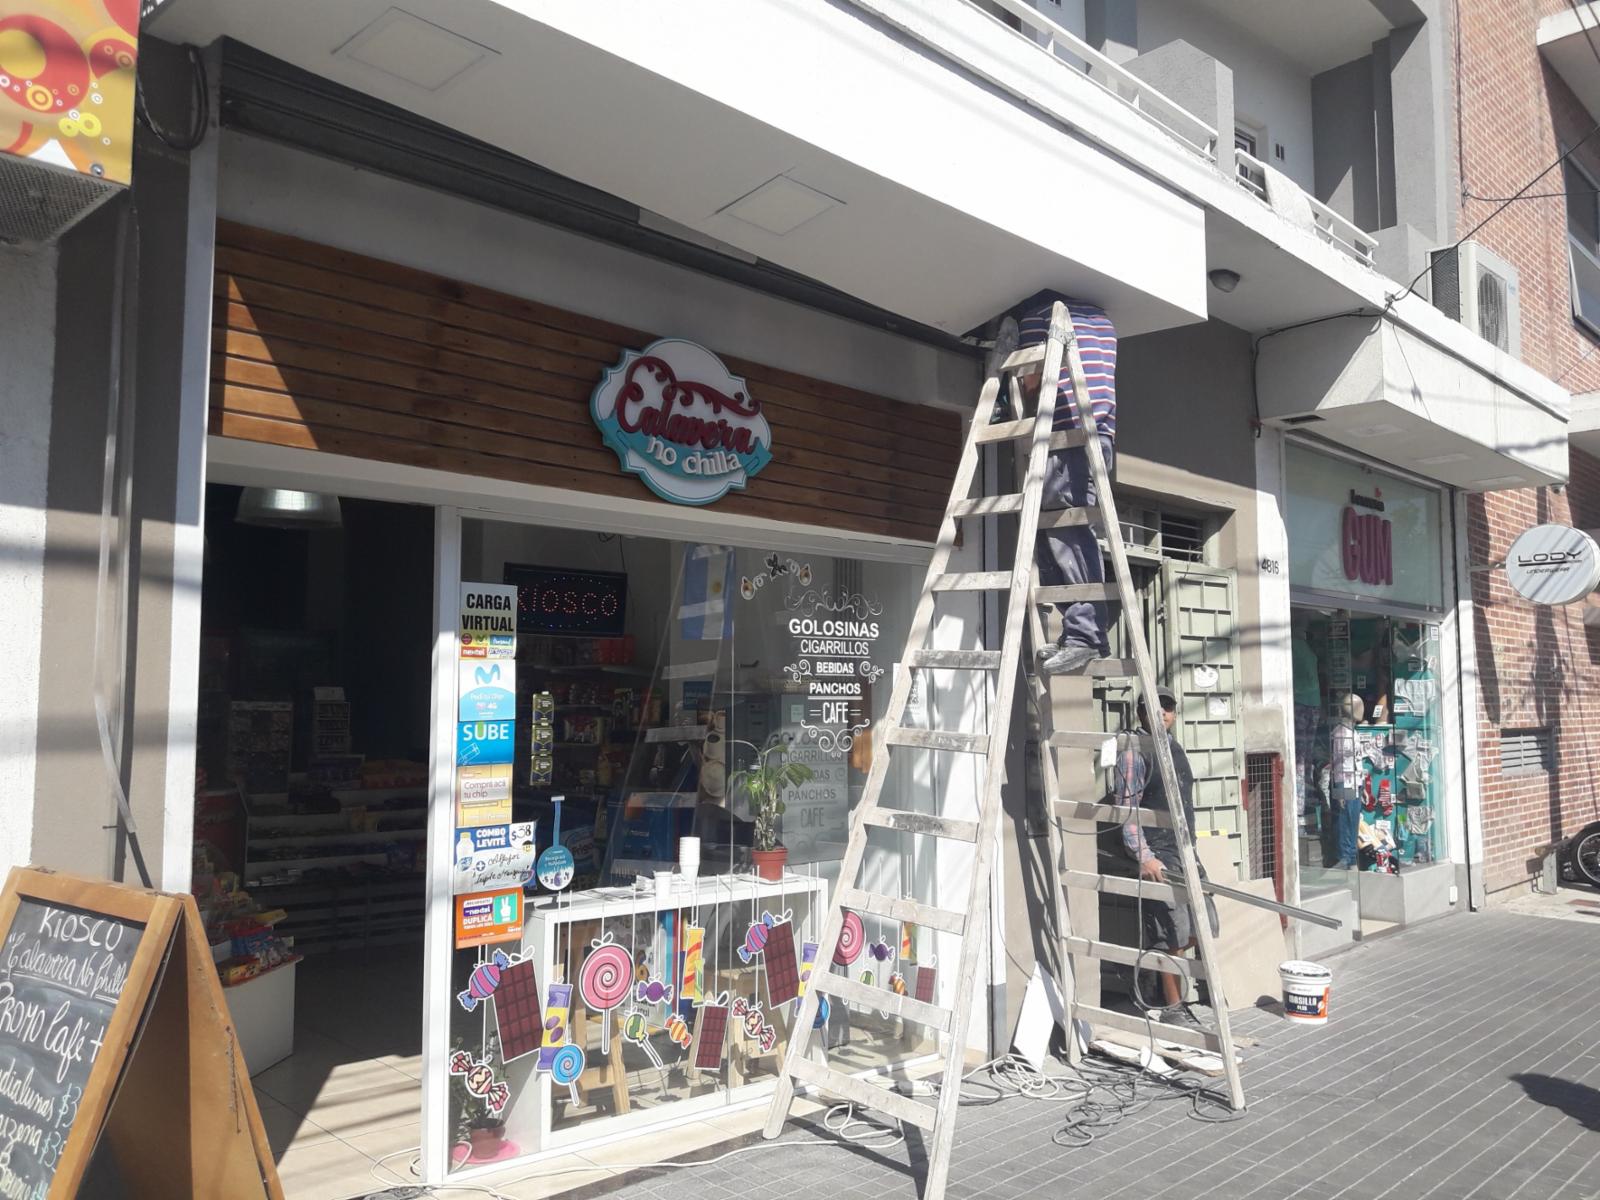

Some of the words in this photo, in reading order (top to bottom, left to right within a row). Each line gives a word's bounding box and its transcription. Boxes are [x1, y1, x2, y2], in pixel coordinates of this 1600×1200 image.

[647, 436, 677, 466] no
[682, 450, 742, 475] chilla
[1518, 551, 1583, 562] LODY
[1261, 558, 1280, 575] 4816
[466, 593, 512, 611] CARGA
[461, 614, 514, 632] VIRTUAL
[788, 618, 880, 638] GOLOSINAS
[800, 639, 869, 655] CIGARRILLOS
[816, 661, 854, 674] BEBIDAS
[809, 682, 861, 694] PANCHOS
[822, 701, 849, 724] CAFE
[463, 723, 509, 741] SUBE
[476, 827, 506, 838] COMBO
